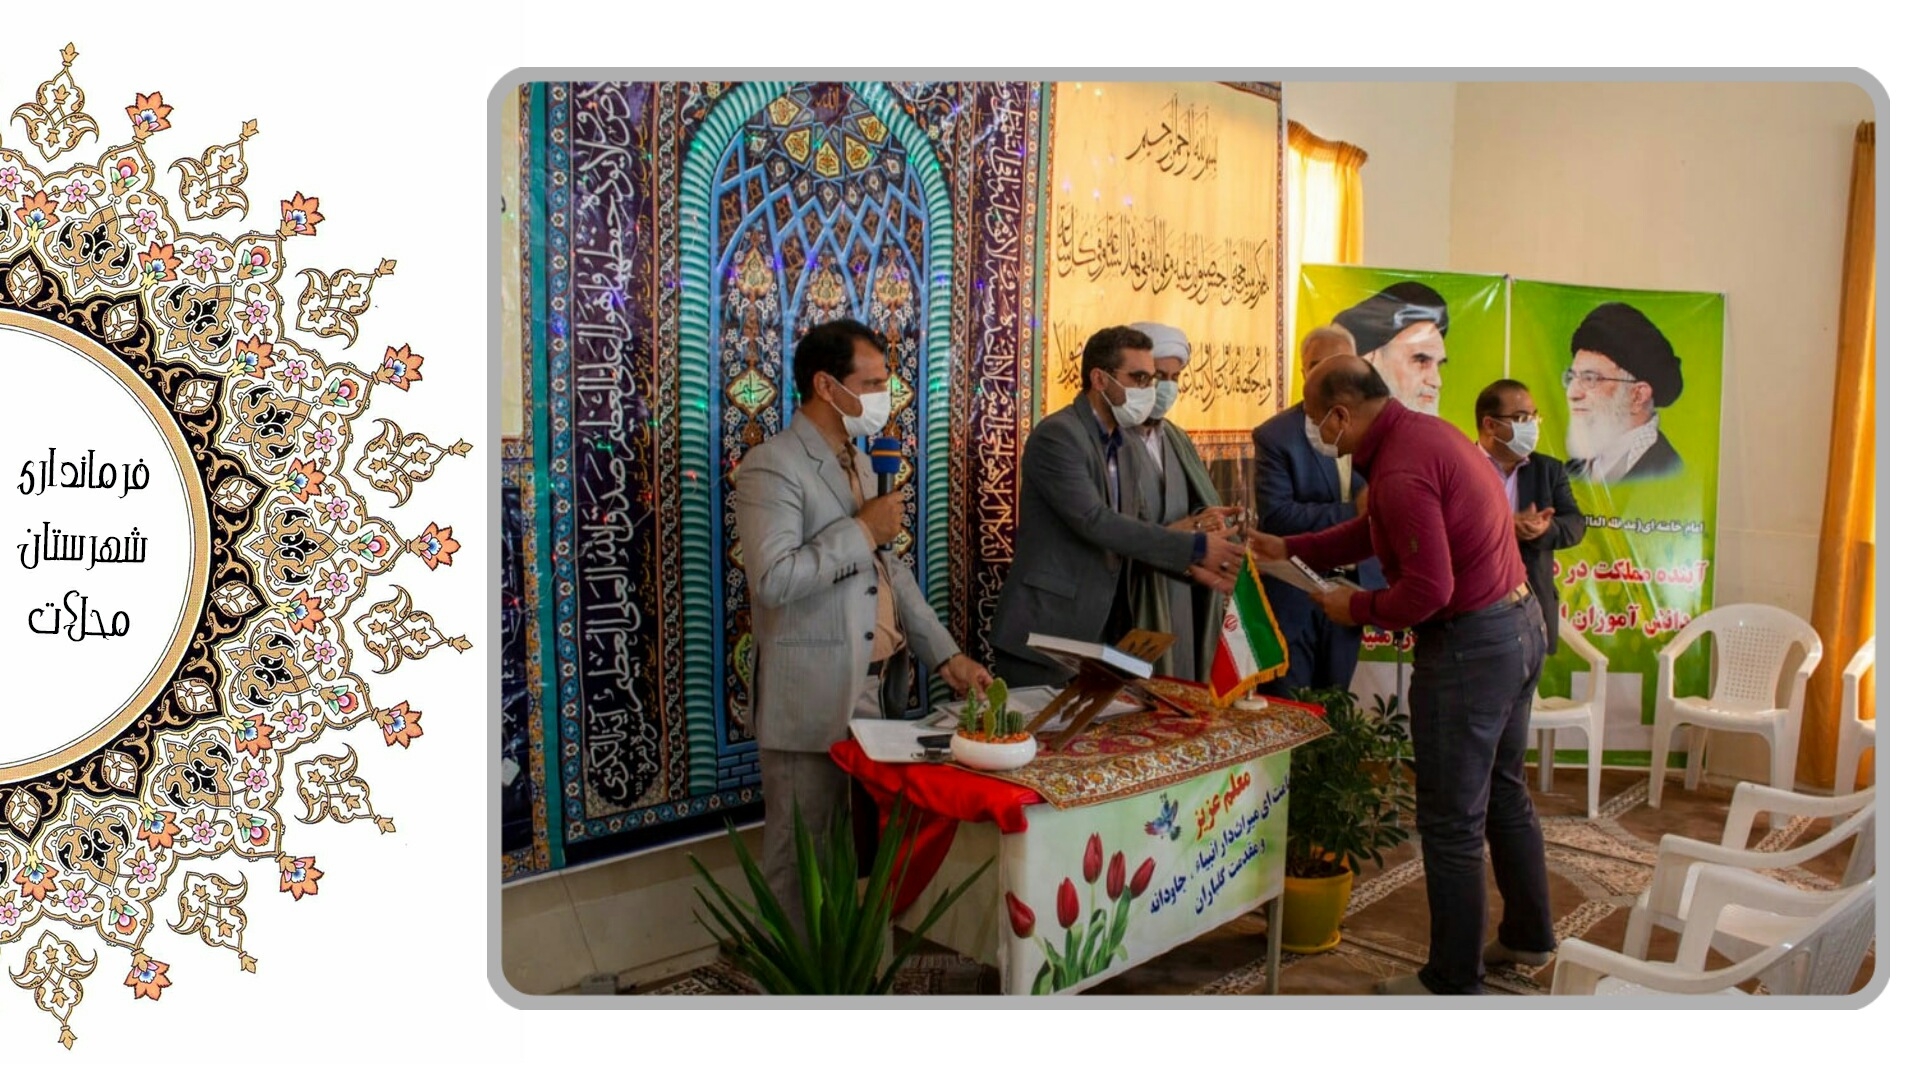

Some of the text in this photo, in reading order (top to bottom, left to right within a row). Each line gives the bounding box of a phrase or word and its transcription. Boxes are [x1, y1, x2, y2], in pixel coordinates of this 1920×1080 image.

[1564, 561, 1588, 584] در
[1593, 561, 1651, 582] مملکت
[1655, 562, 1708, 588] آینده
[1571, 604, 1640, 634] آموزان
[1194, 771, 1251, 840] معلم عزیز
[1150, 873, 1187, 914] جاودانه
[1194, 866, 1225, 915] گلباران
